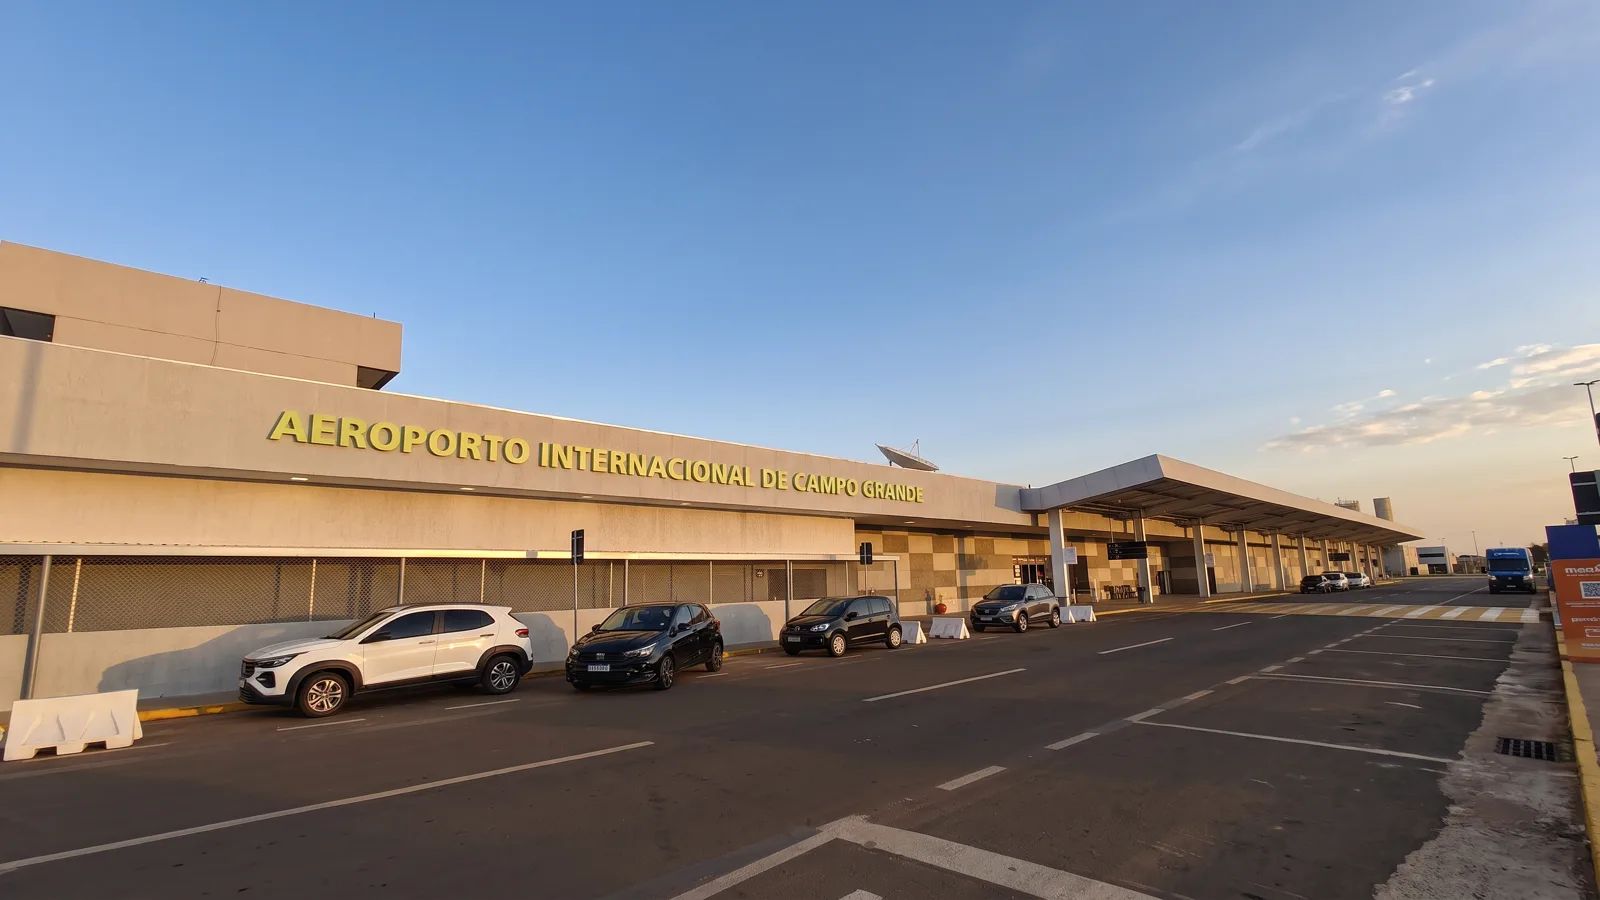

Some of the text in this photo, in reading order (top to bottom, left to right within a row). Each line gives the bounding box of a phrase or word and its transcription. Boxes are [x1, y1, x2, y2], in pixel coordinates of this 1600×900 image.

[268, 410, 925, 504] AEROPORTO INTERNACIONAL DE CAMPO GRANDE
